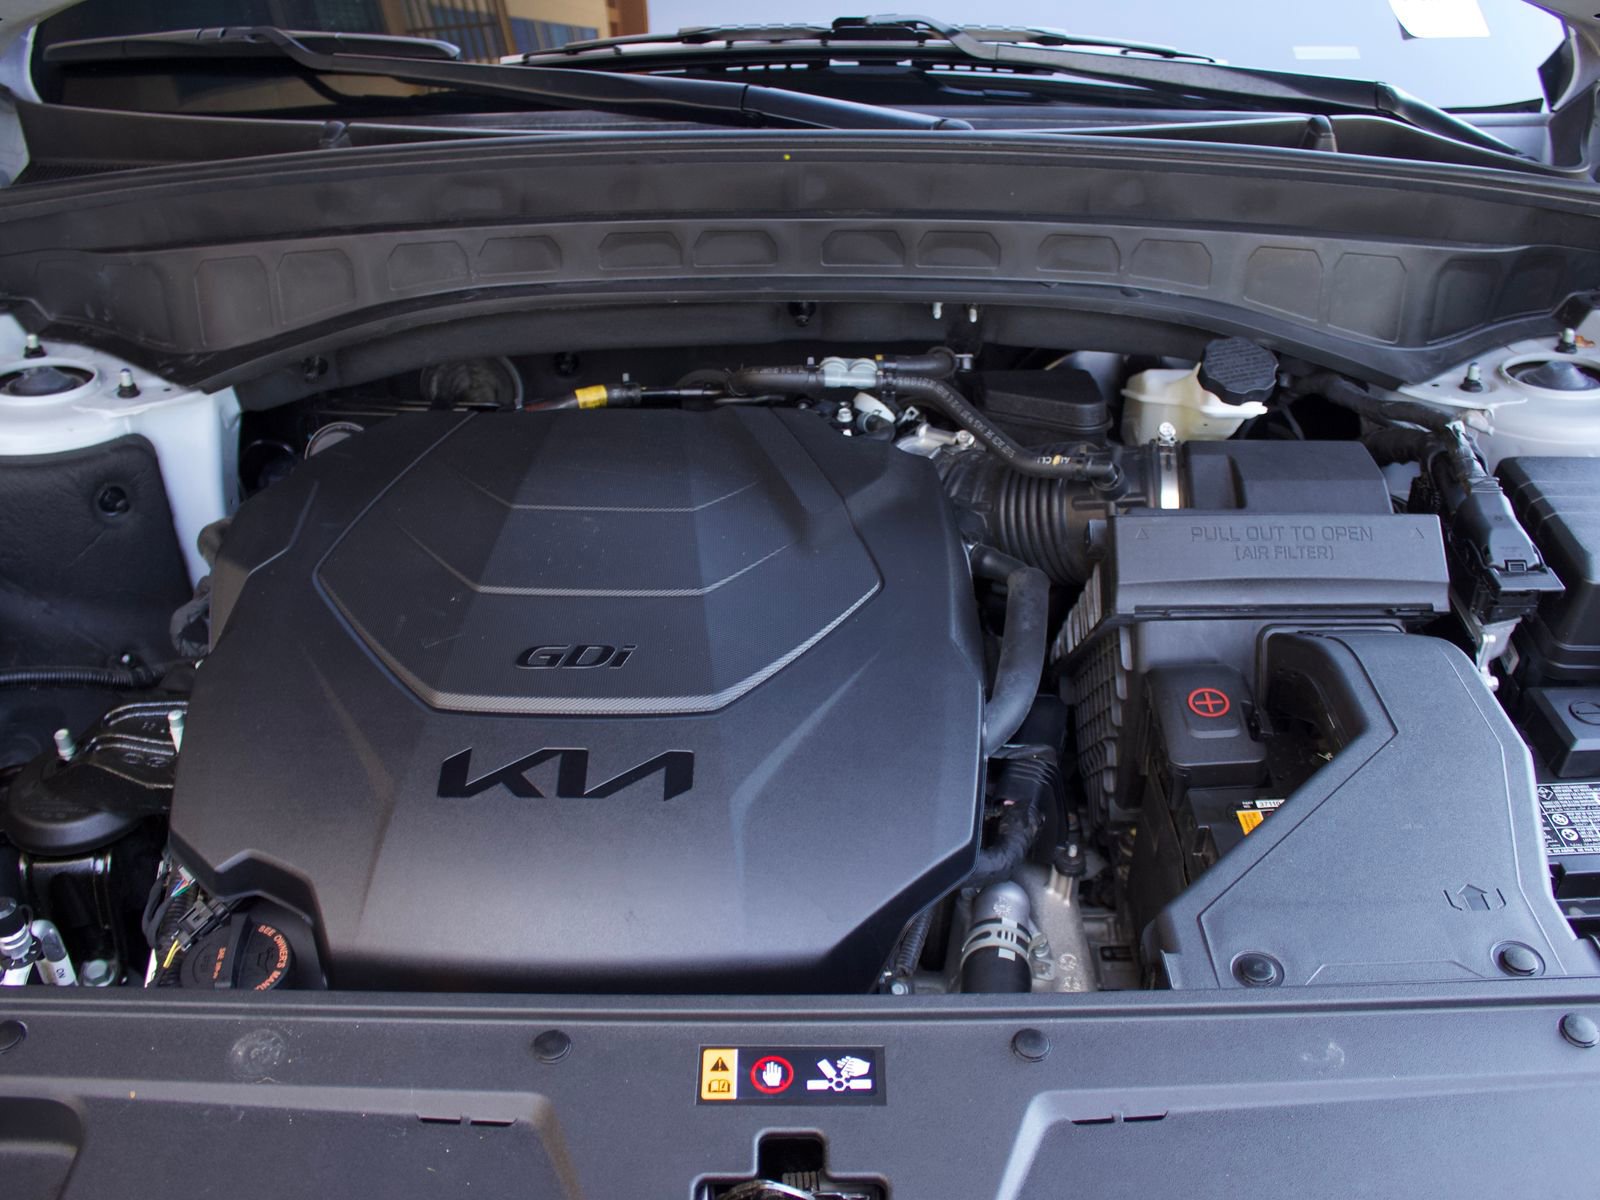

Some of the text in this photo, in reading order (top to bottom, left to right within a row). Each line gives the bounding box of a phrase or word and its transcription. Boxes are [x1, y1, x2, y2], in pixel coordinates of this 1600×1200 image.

[1191, 526, 1373, 542] PULL OUT TO OPEN
[515, 644, 638, 669] GDi
[437, 746, 694, 801] KIA
[258, 924, 277, 937] SEE
